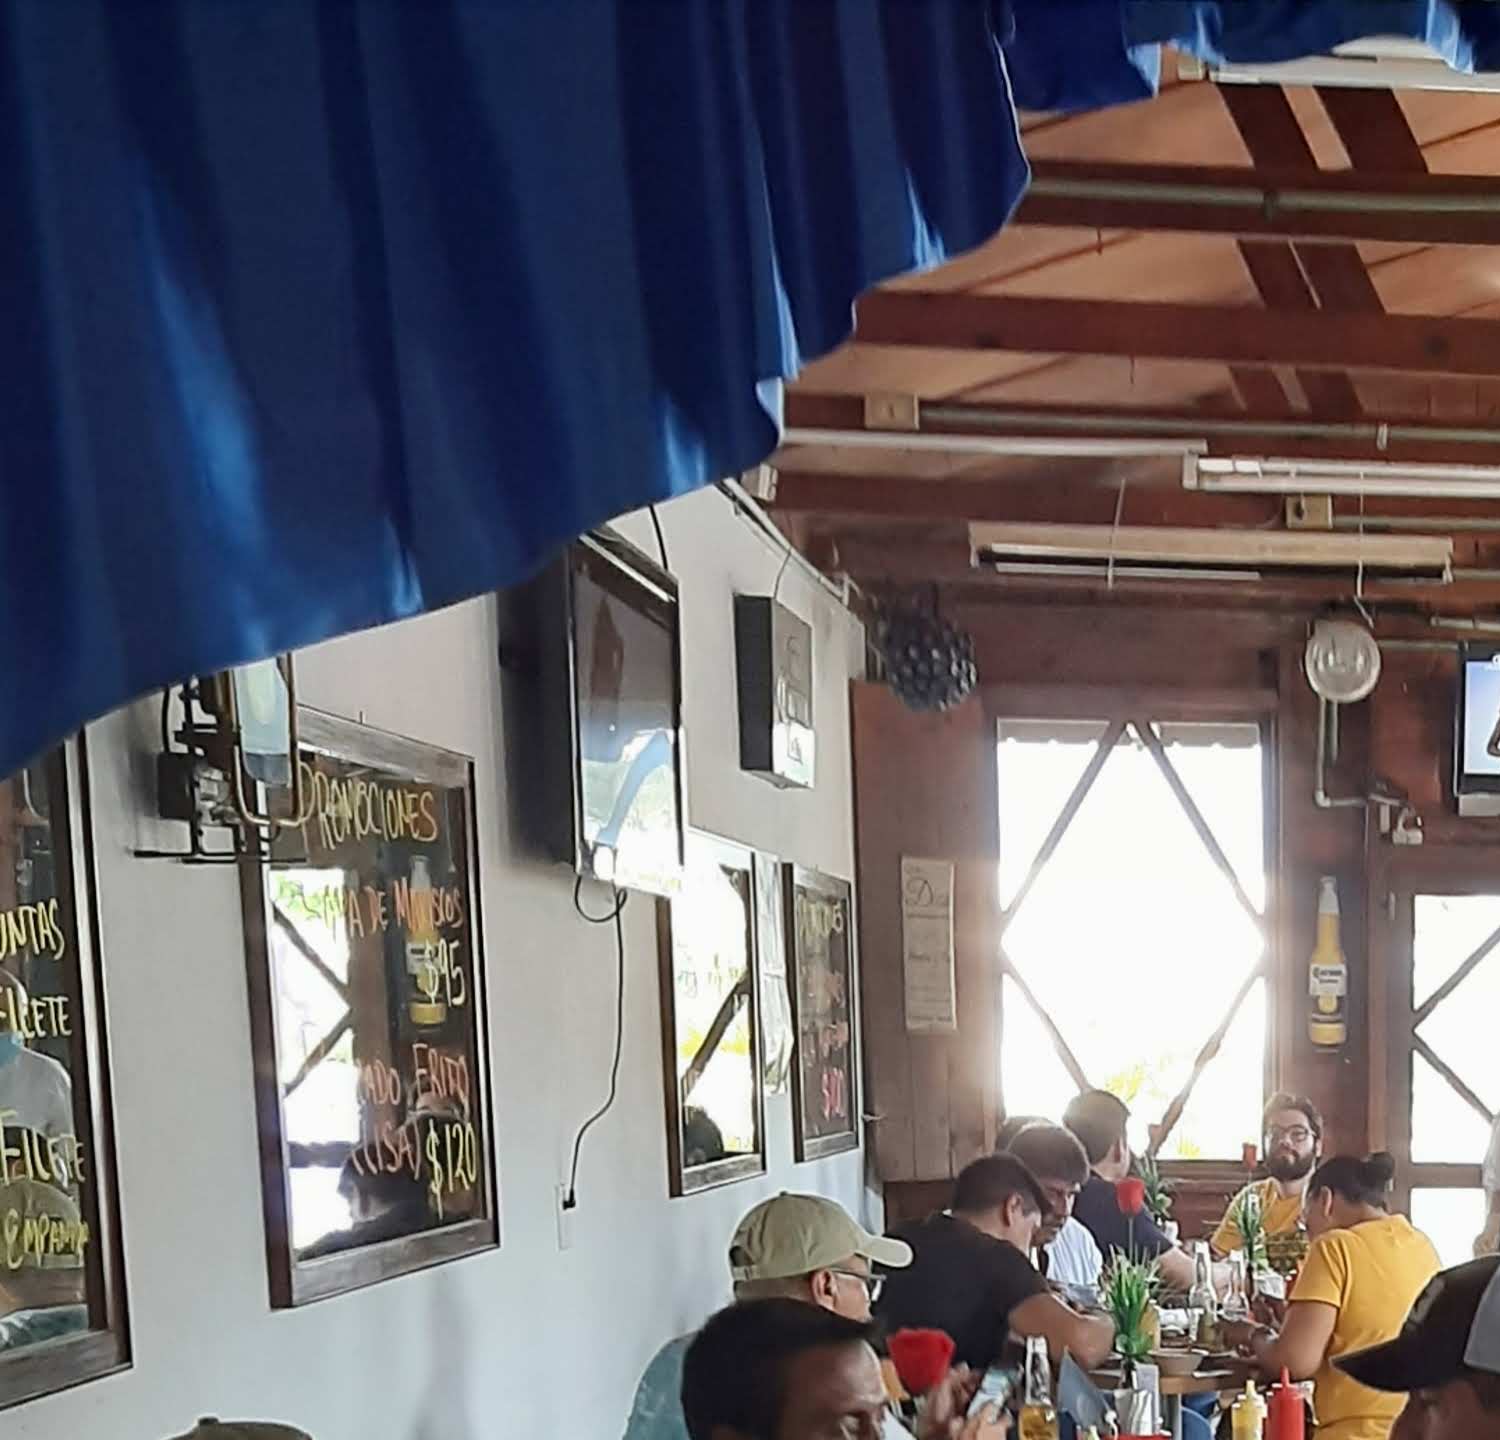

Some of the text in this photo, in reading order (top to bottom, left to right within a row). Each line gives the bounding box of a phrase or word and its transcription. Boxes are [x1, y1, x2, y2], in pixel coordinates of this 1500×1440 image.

[298, 759, 438, 853] PROMOCIONES
[425, 937, 466, 1008] $95
[426, 1118, 477, 1220] $120
